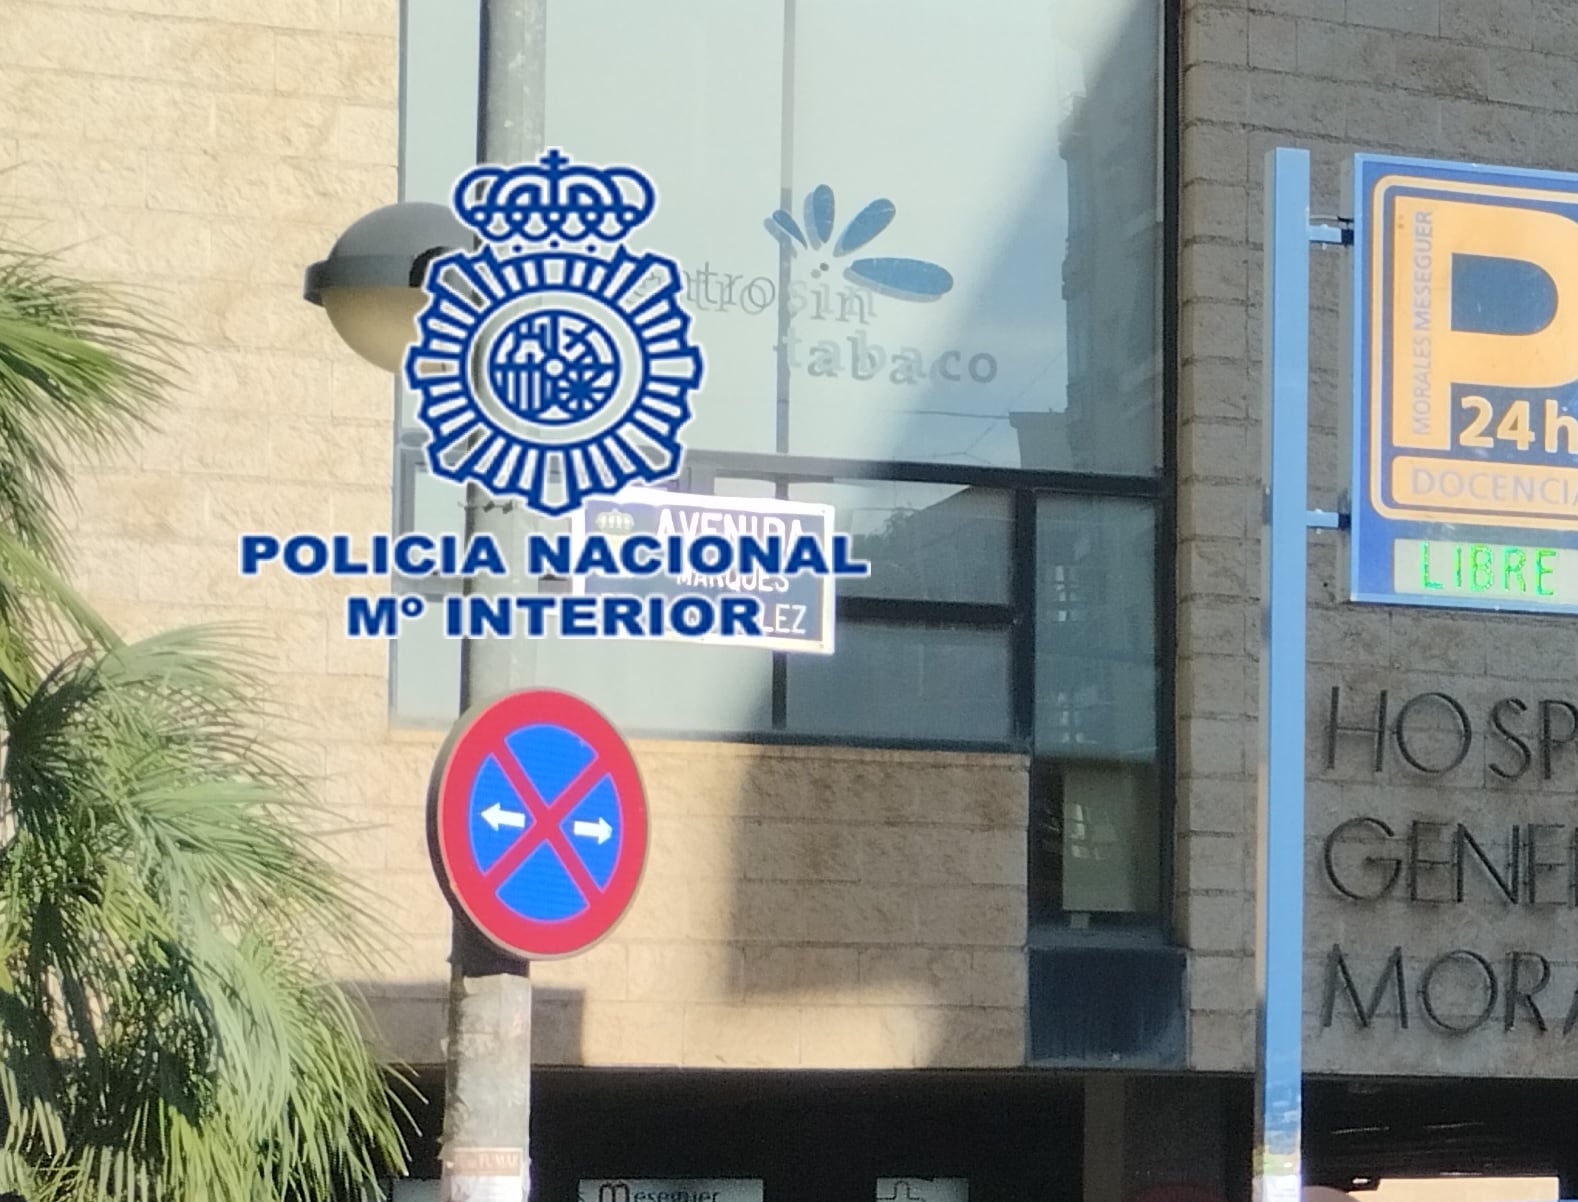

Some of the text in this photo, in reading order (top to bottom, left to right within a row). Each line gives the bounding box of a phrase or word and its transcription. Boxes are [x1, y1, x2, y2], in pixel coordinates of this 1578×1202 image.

[1412, 210, 1434, 437] MORALES MESEGUER
[1420, 542, 1558, 596] LIBRE
